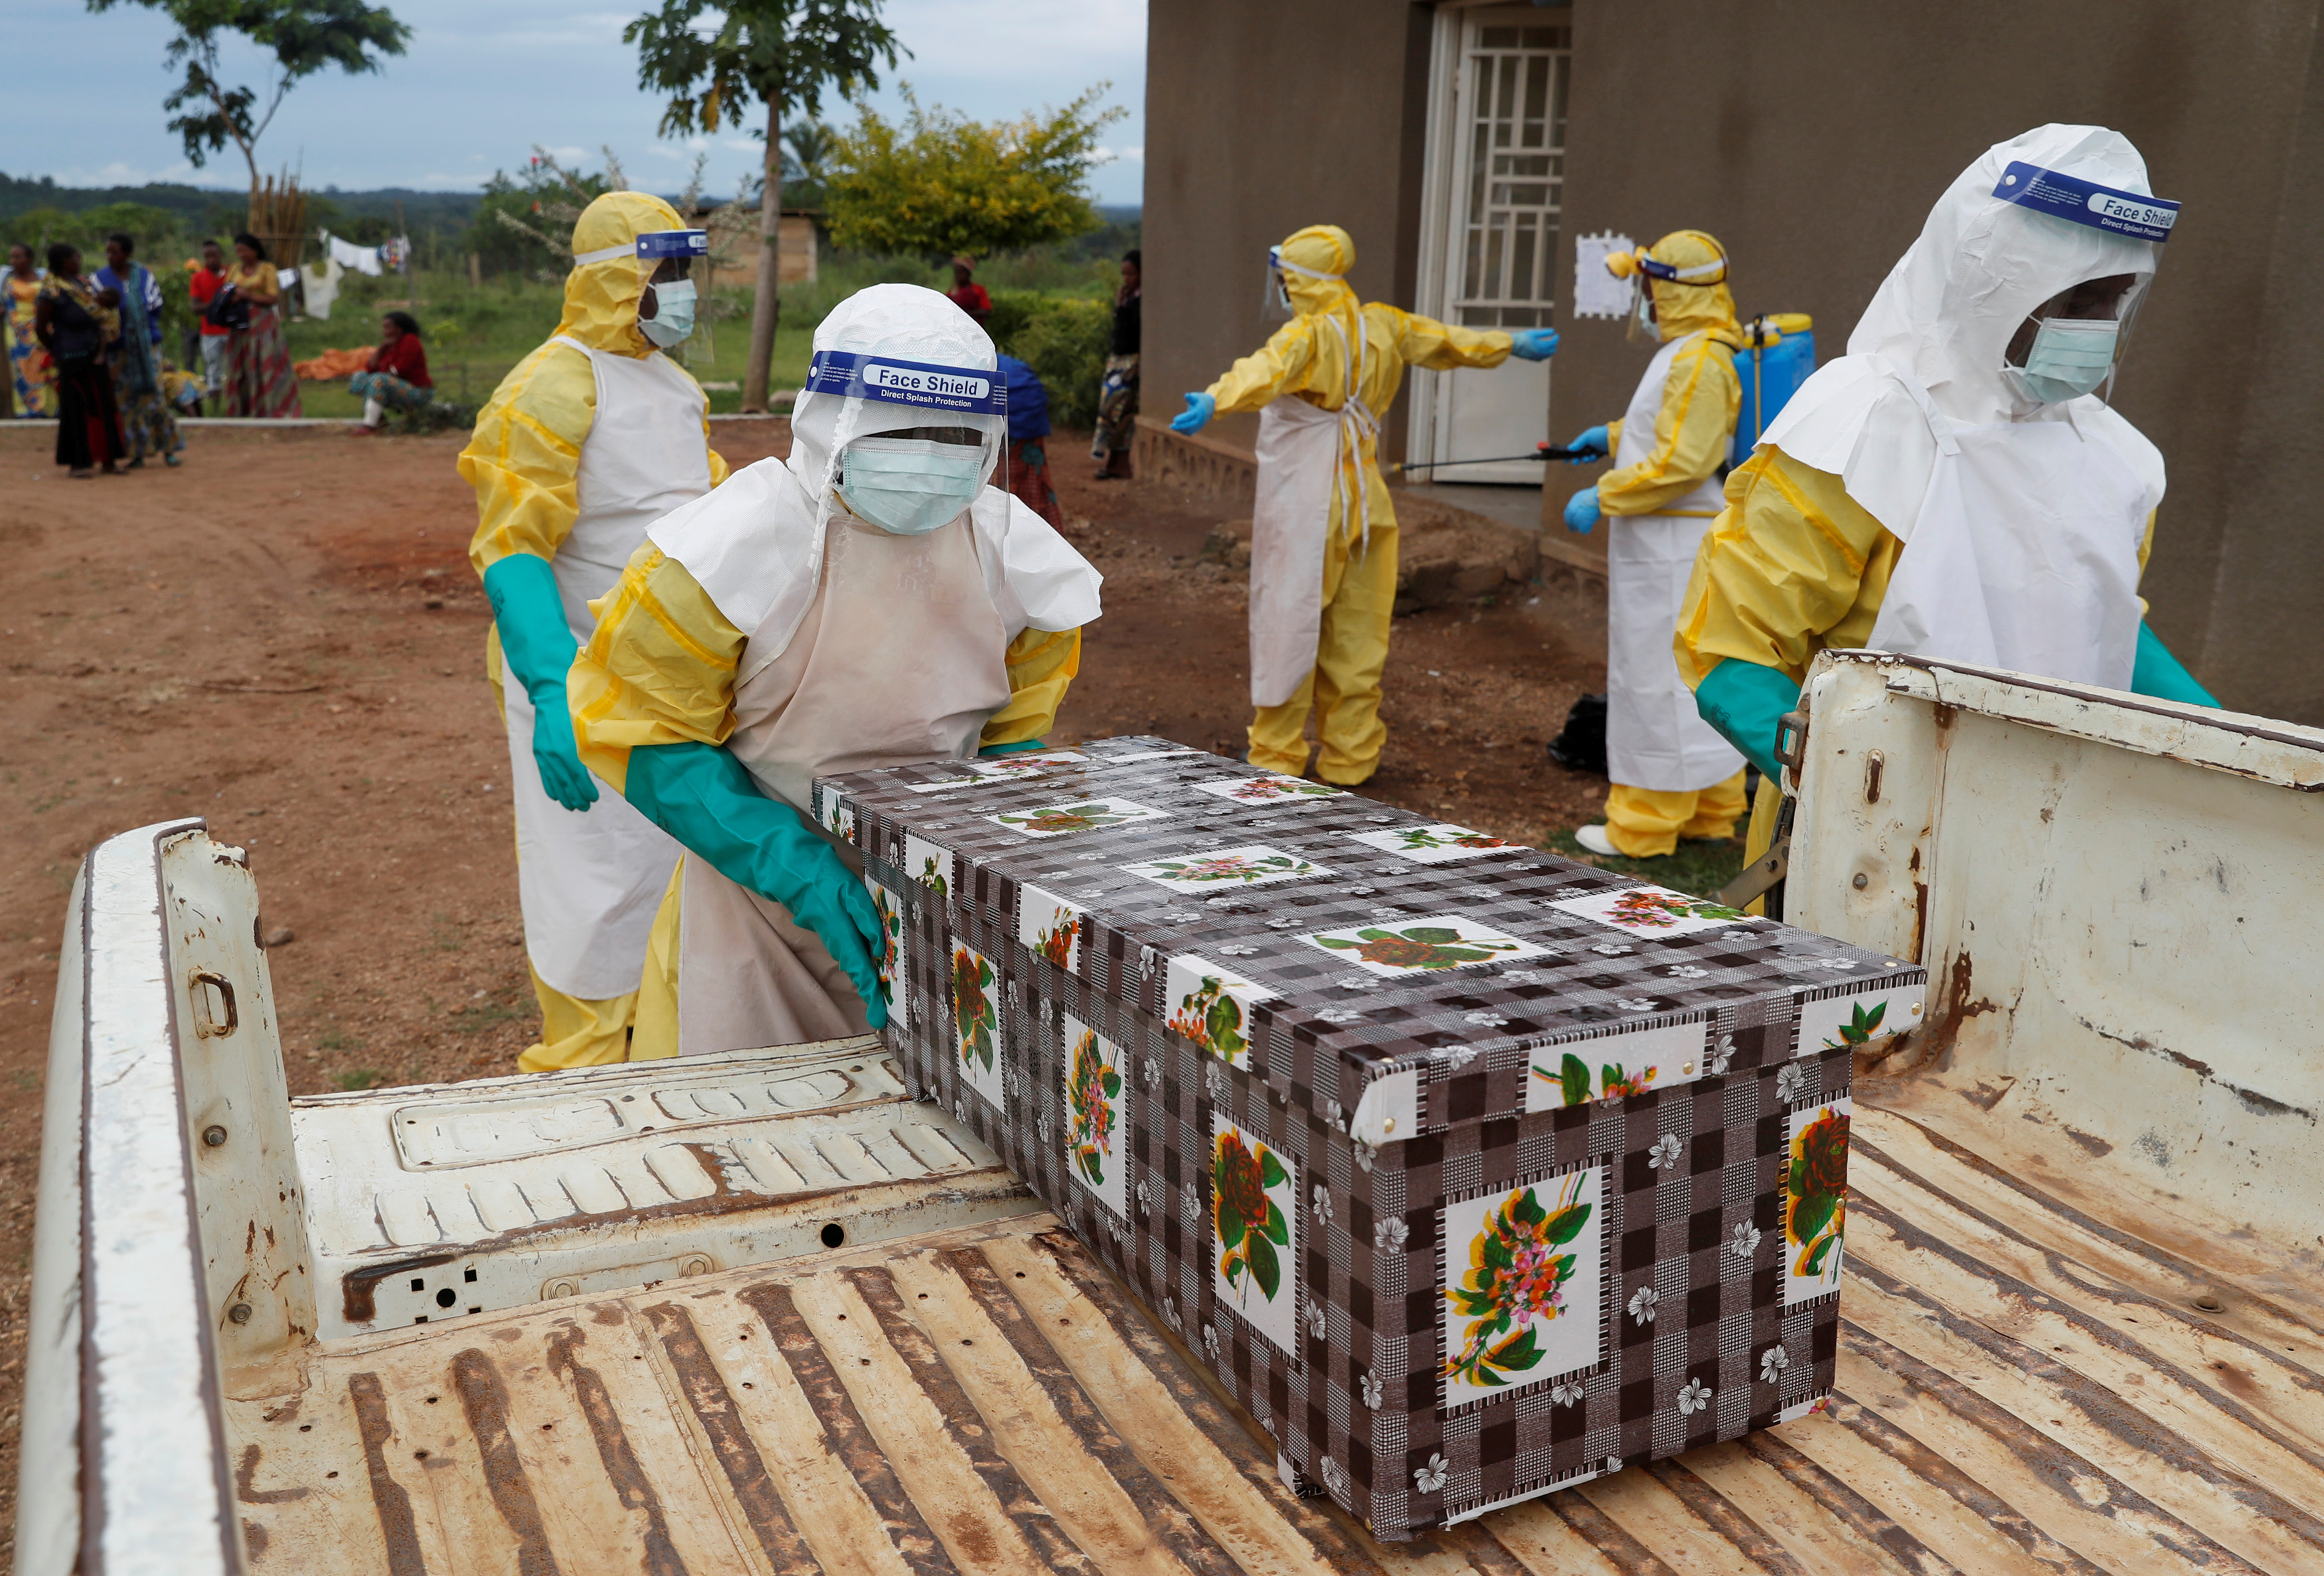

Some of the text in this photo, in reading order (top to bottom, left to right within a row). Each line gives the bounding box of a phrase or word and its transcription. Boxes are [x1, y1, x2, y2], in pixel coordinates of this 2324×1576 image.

[2103, 199, 2173, 226] Face Shield
[2101, 217, 2165, 238] Direct Splash Protection
[879, 369, 920, 388] Face
[927, 376, 977, 396] Shield
[880, 389, 971, 408] Direct Splash Protection
